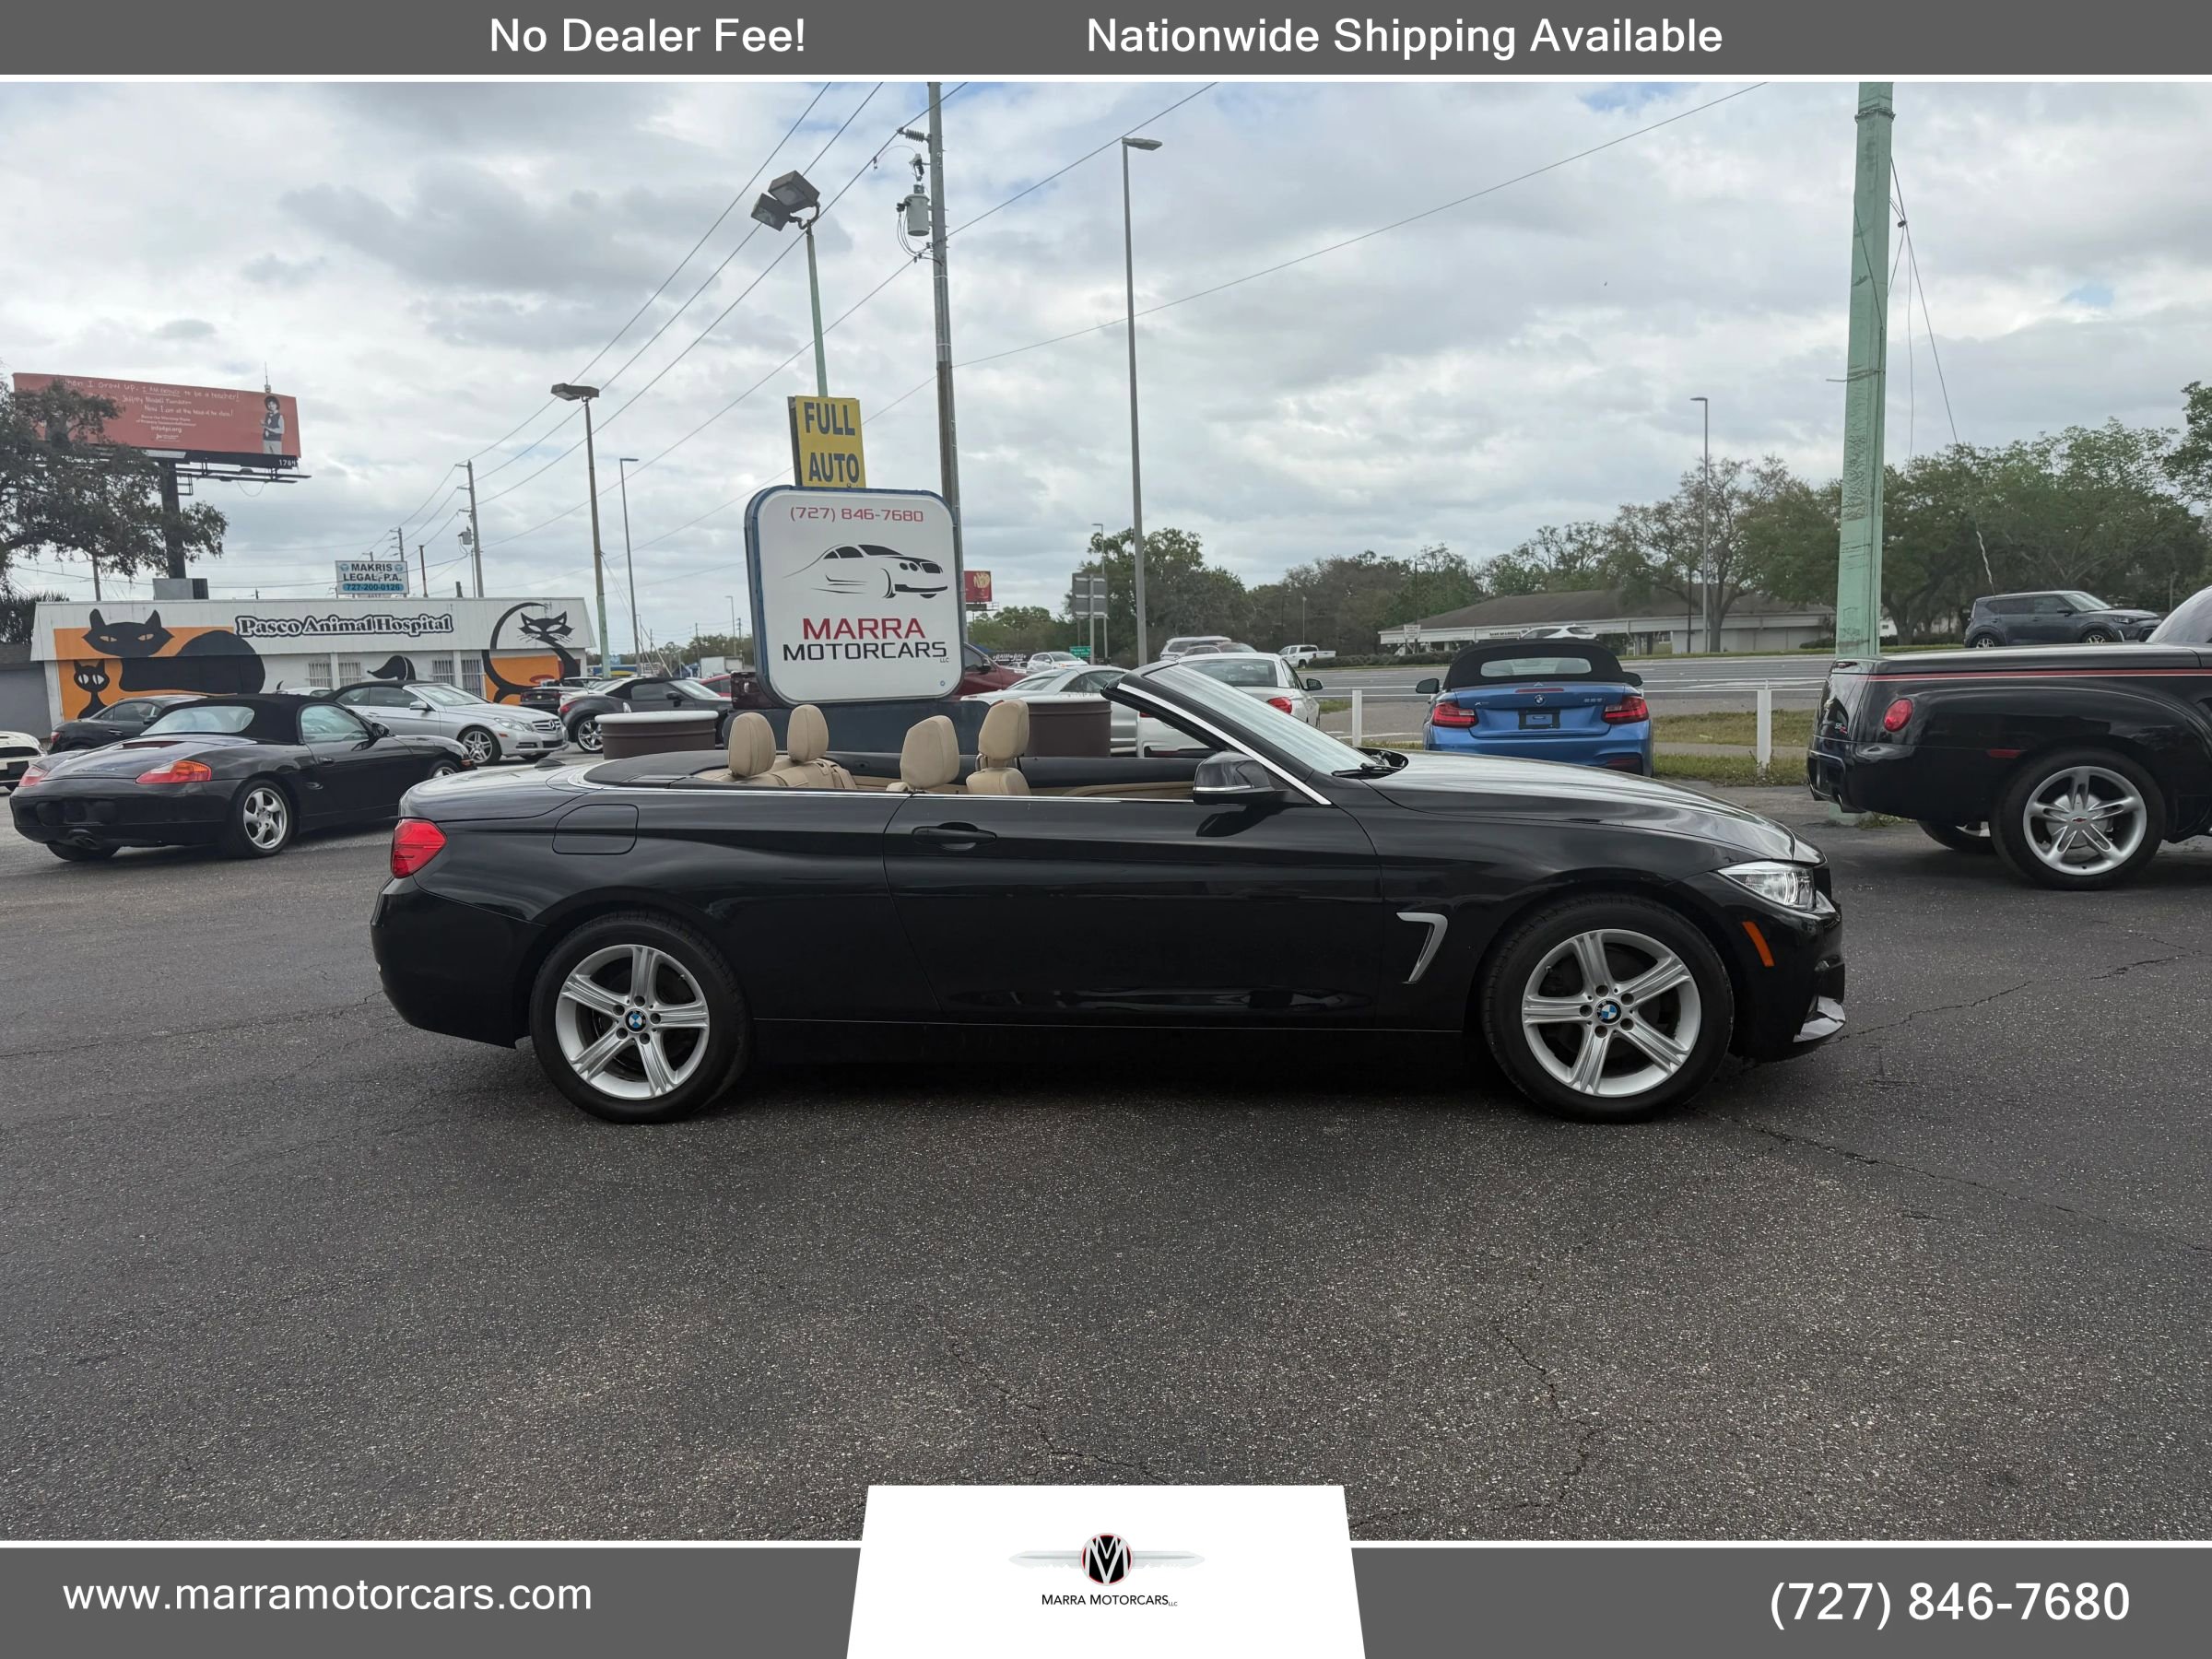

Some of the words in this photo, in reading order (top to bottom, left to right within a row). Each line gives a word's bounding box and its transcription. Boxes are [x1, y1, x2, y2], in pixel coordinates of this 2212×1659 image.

[804, 401, 855, 436] FULL
[809, 453, 860, 483] AUTO
[791, 506, 836, 522] (727)
[841, 508, 924, 523] 846-7680
[351, 563, 394, 571] MAKRIS
[383, 573, 403, 582] P.A.
[238, 617, 302, 636] Pasco
[303, 615, 374, 635] Animal
[374, 614, 453, 637] Hospital
[803, 618, 926, 640] MARRA
[783, 641, 947, 661] MOTORCARS
